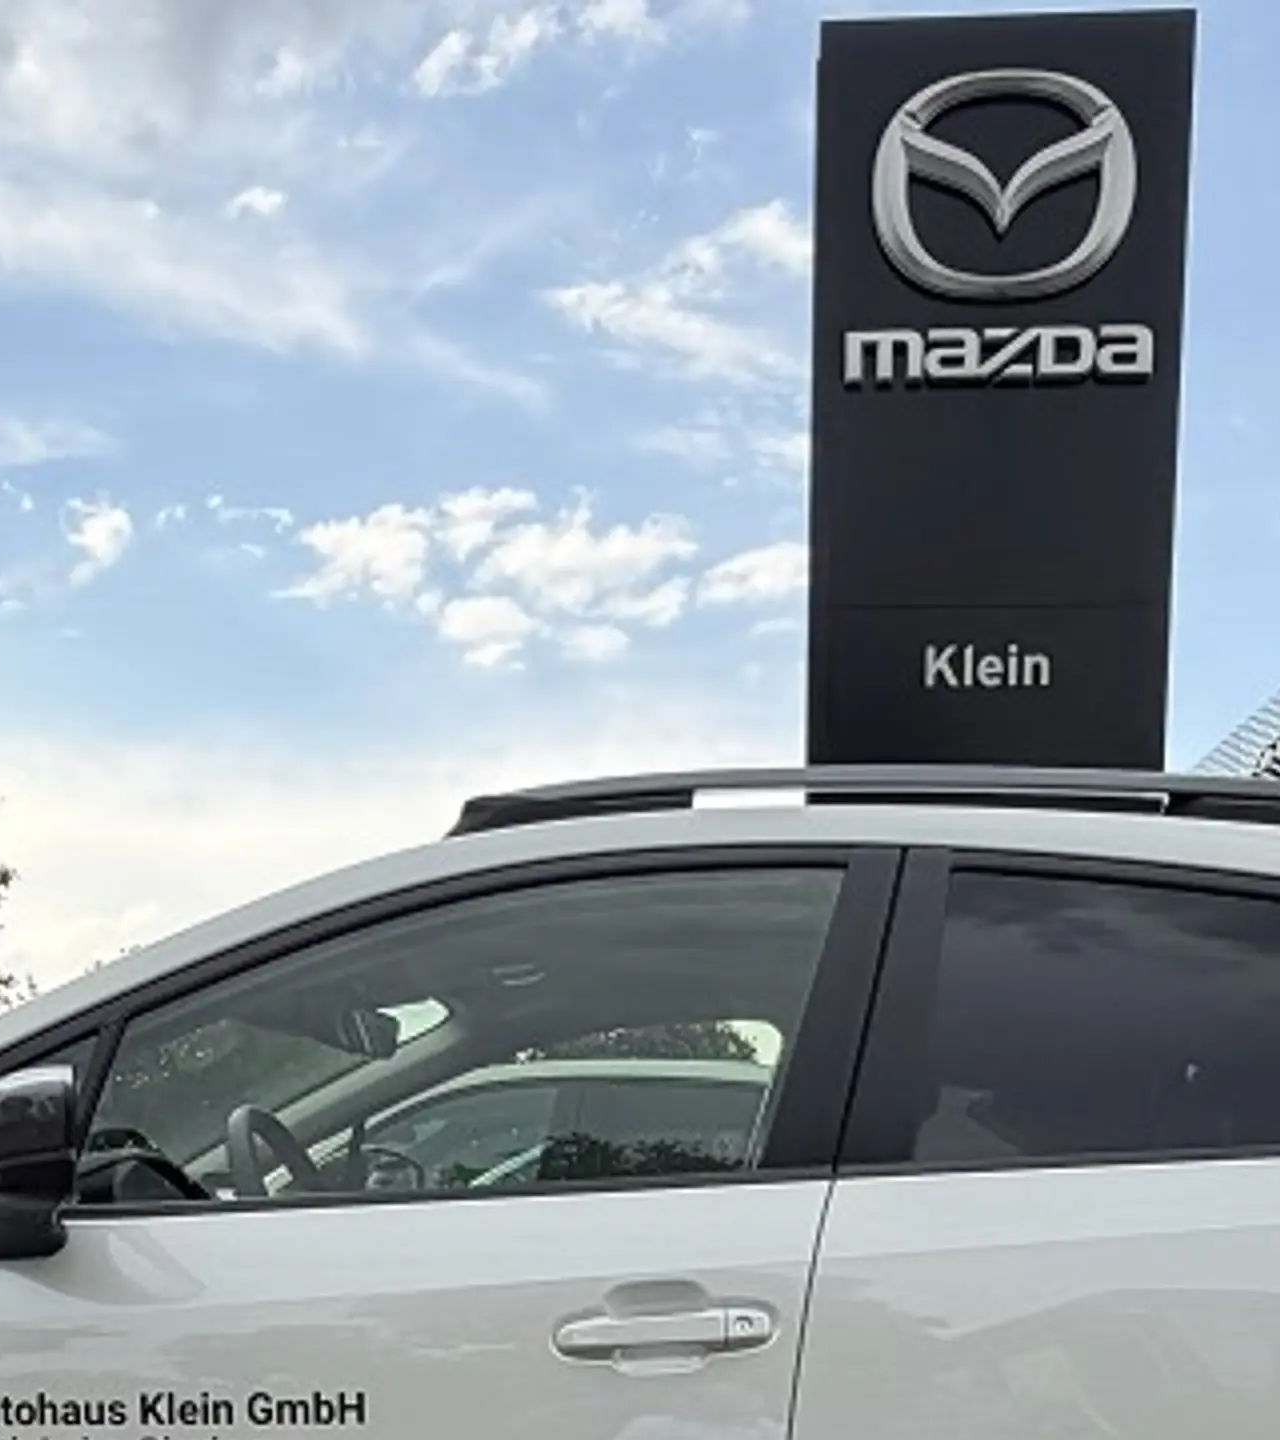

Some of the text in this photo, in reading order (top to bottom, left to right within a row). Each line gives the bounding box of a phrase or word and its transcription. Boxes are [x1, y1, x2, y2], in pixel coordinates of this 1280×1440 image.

[923, 644, 1051, 690] Klein
[139, 1391, 234, 1425] Klein
[247, 1392, 366, 1425] GmbH
